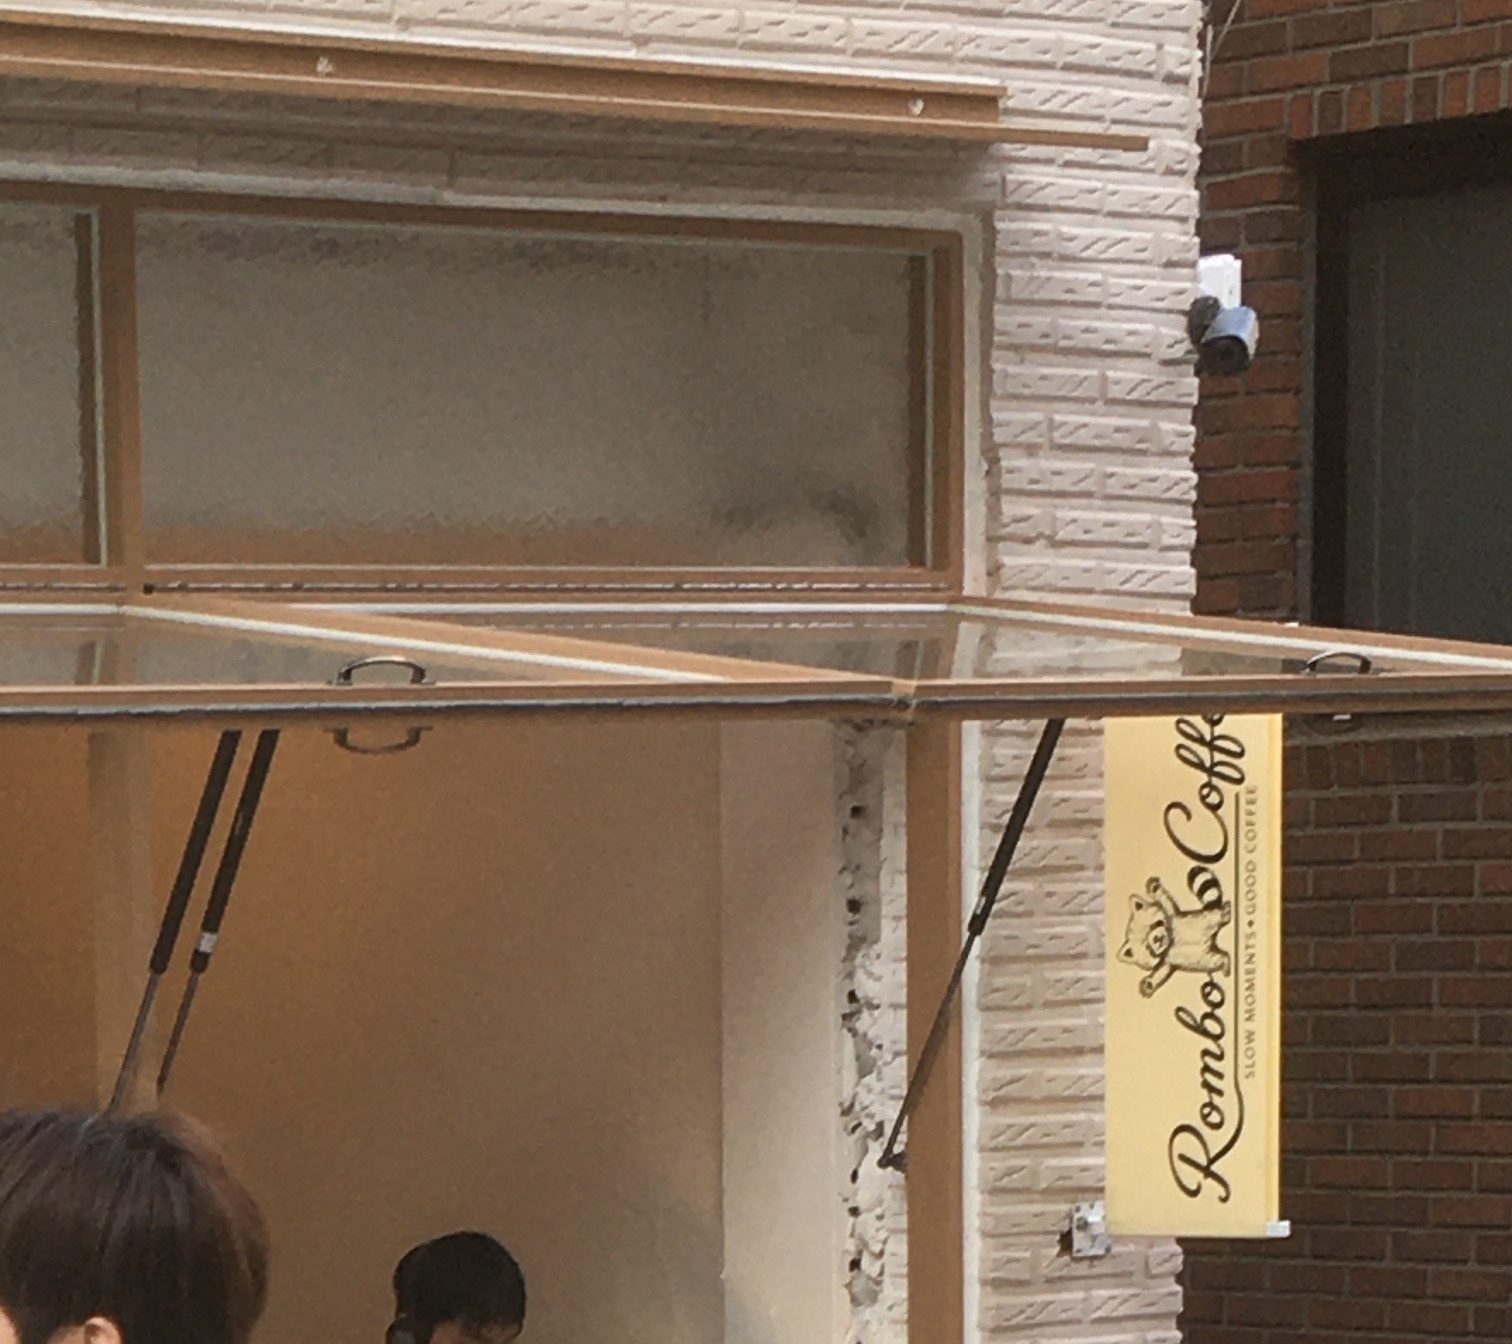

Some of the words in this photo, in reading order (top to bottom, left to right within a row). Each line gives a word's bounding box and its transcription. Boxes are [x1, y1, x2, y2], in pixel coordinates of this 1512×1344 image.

[1245, 784, 1258, 855] COFFEE
[1244, 859, 1257, 915] GOOD
[1244, 931, 1258, 1023] MOMENTS
[1167, 973, 1245, 1203] Rombo
[1244, 1030, 1257, 1080] SLOW
